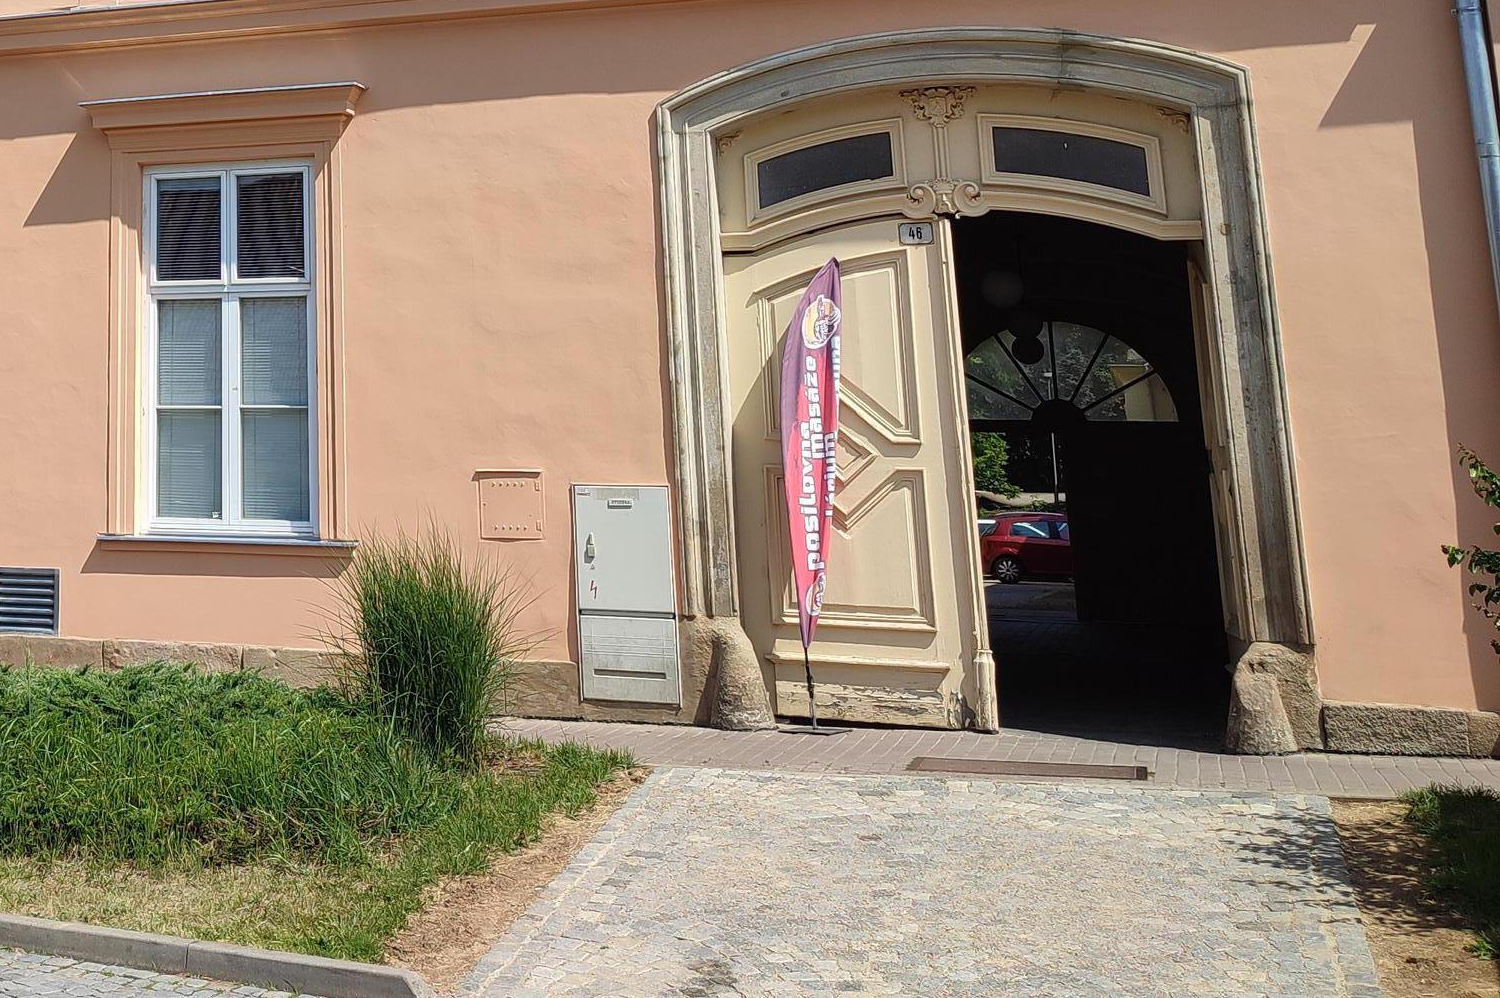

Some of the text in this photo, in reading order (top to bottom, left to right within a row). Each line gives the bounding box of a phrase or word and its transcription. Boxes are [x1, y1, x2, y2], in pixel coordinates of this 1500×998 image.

[908, 226, 923, 240] 46
[804, 355, 825, 459] masáže
[799, 421, 825, 571] posilovna
